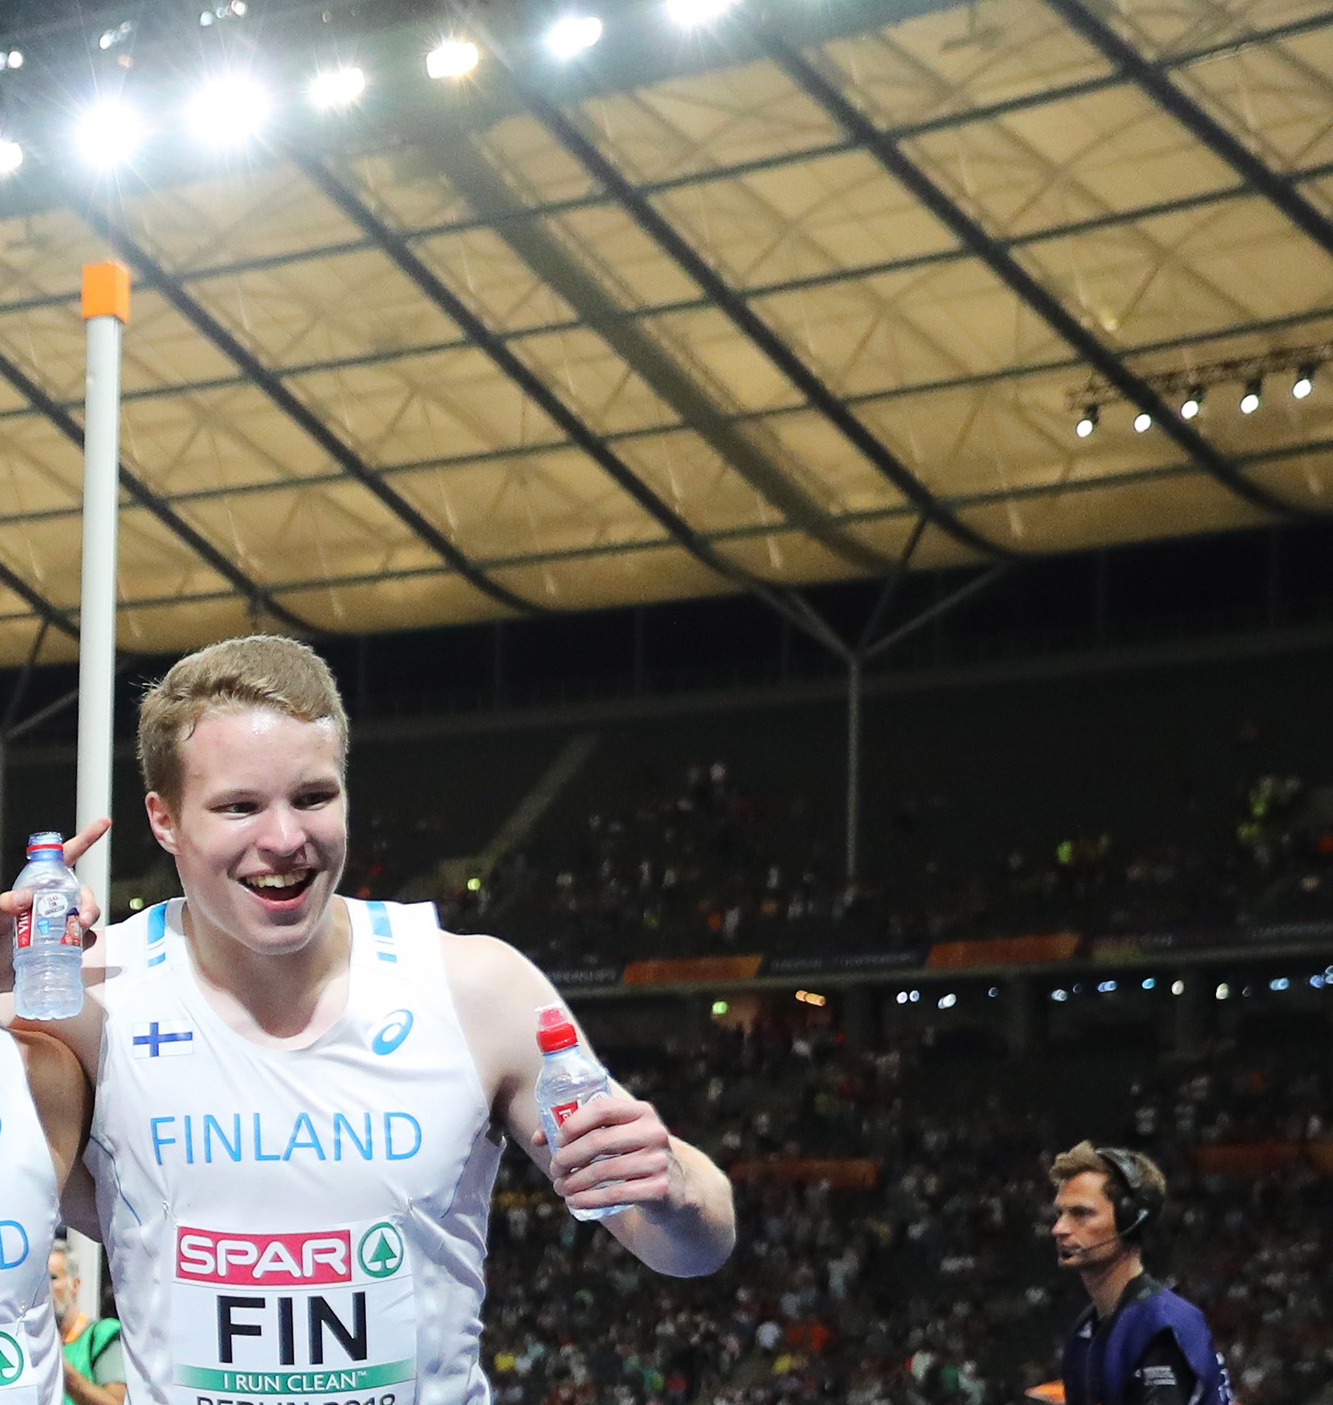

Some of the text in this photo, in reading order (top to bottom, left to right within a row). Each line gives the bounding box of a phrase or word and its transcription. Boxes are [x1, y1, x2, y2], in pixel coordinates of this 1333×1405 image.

[150, 1111, 423, 1166] FINLAND
[179, 1233, 348, 1279] SPAR
[216, 1291, 369, 1366] FIN
[224, 1373, 229, 1389] I
[235, 1374, 281, 1391] RUN
